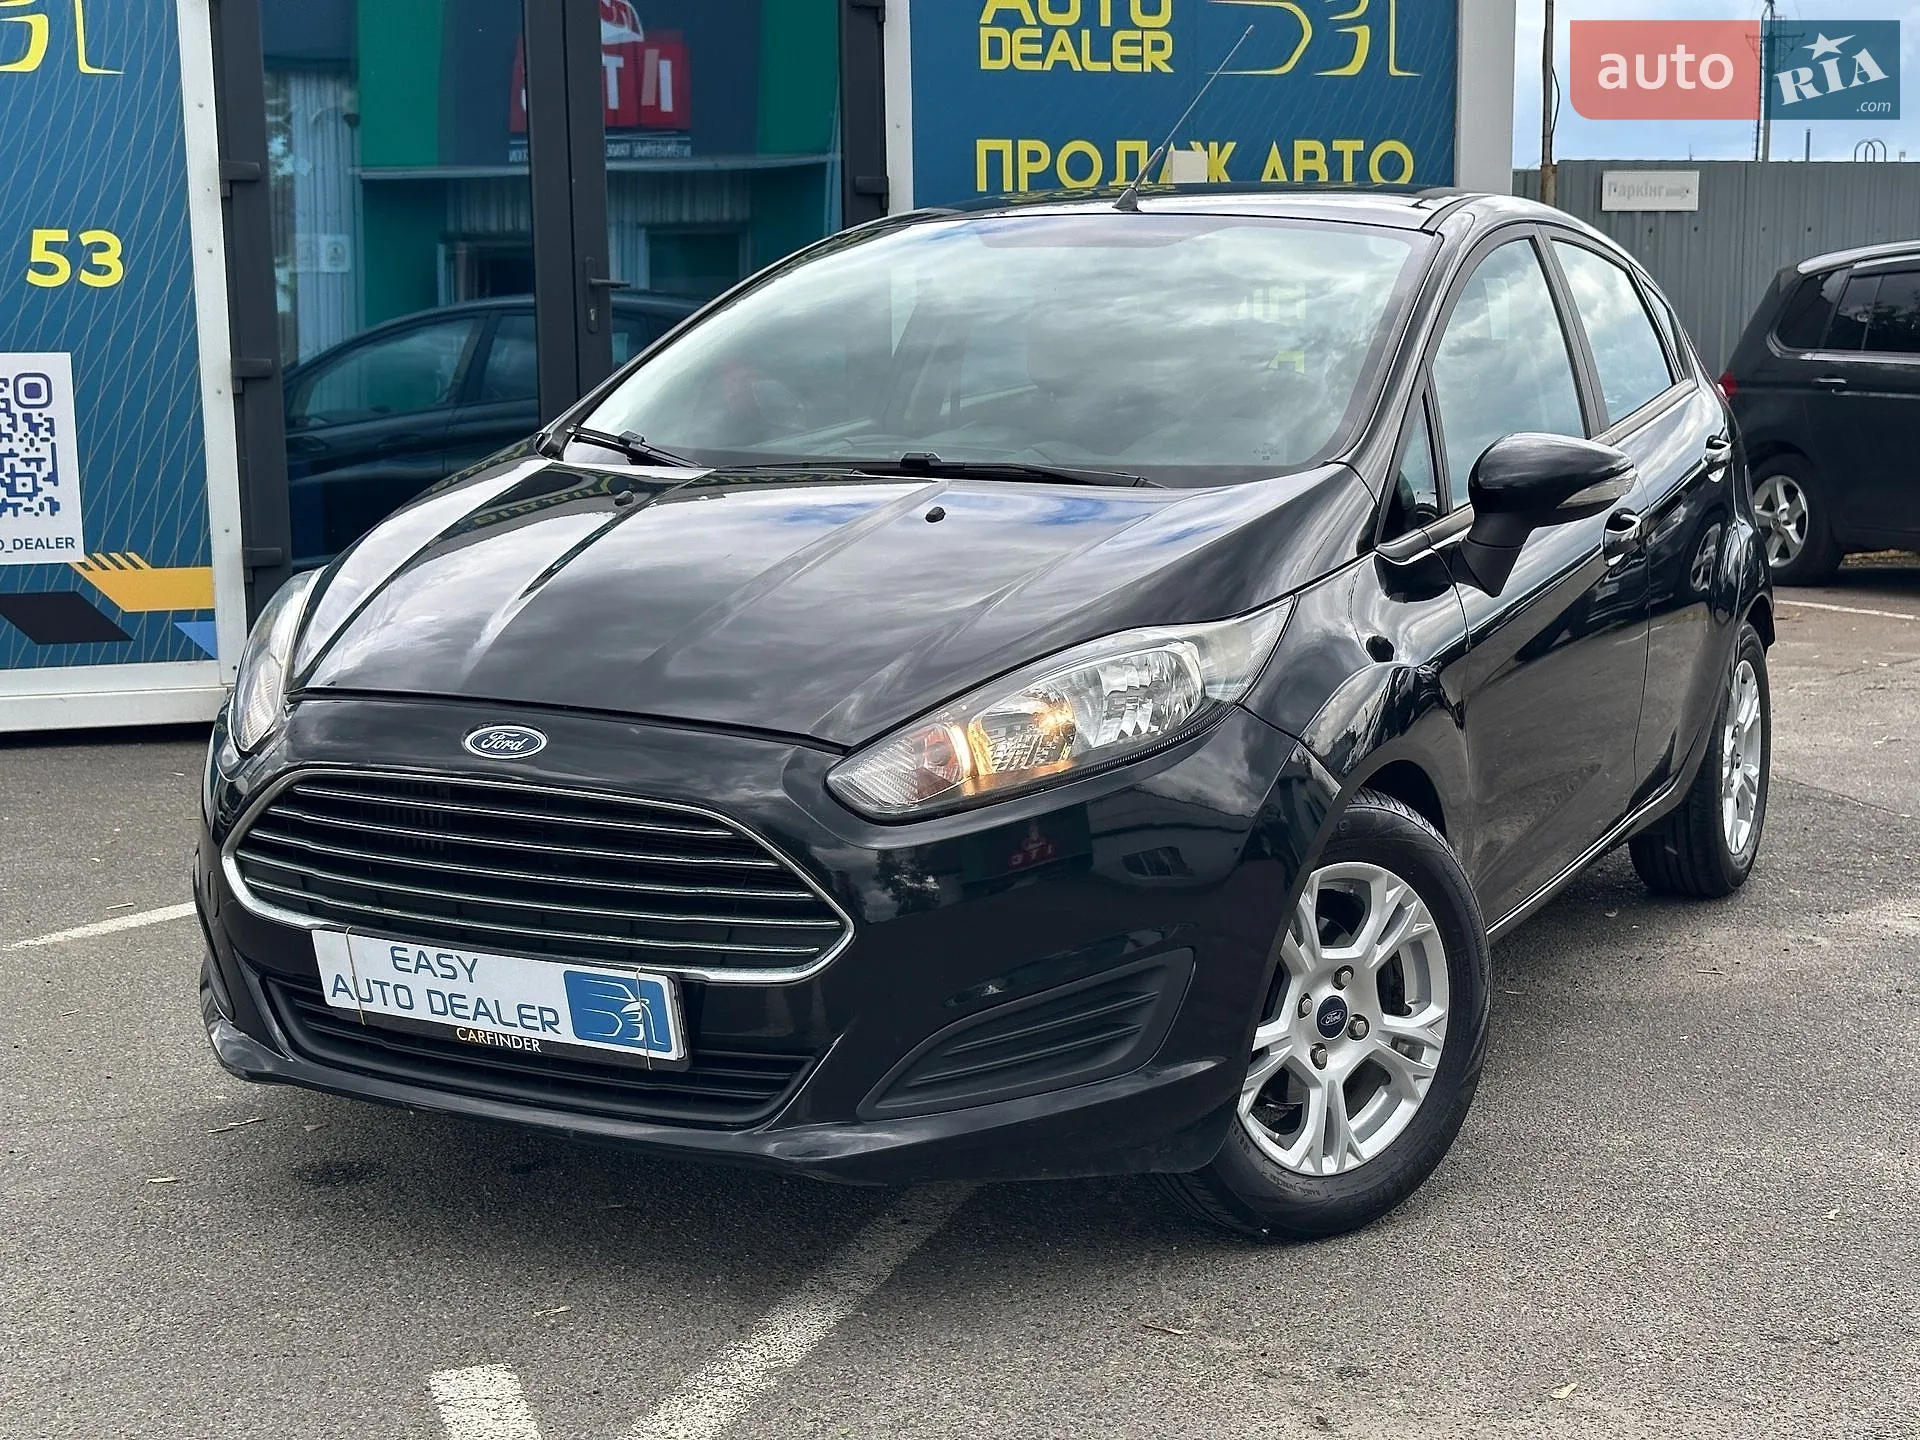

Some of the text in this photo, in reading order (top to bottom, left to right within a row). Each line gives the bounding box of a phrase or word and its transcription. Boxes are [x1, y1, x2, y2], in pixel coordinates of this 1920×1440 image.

[979, 0, 1172, 28] AUTO
[979, 27, 1174, 73] DEALER
[1260, 139, 1415, 185] АВТО
[26, 229, 124, 288] 53
[480, 730, 529, 751] Ford
[390, 945, 479, 983] EASY
[331, 973, 562, 1035] AUTO DEALER
[455, 1027, 542, 1053] CARFINDER
